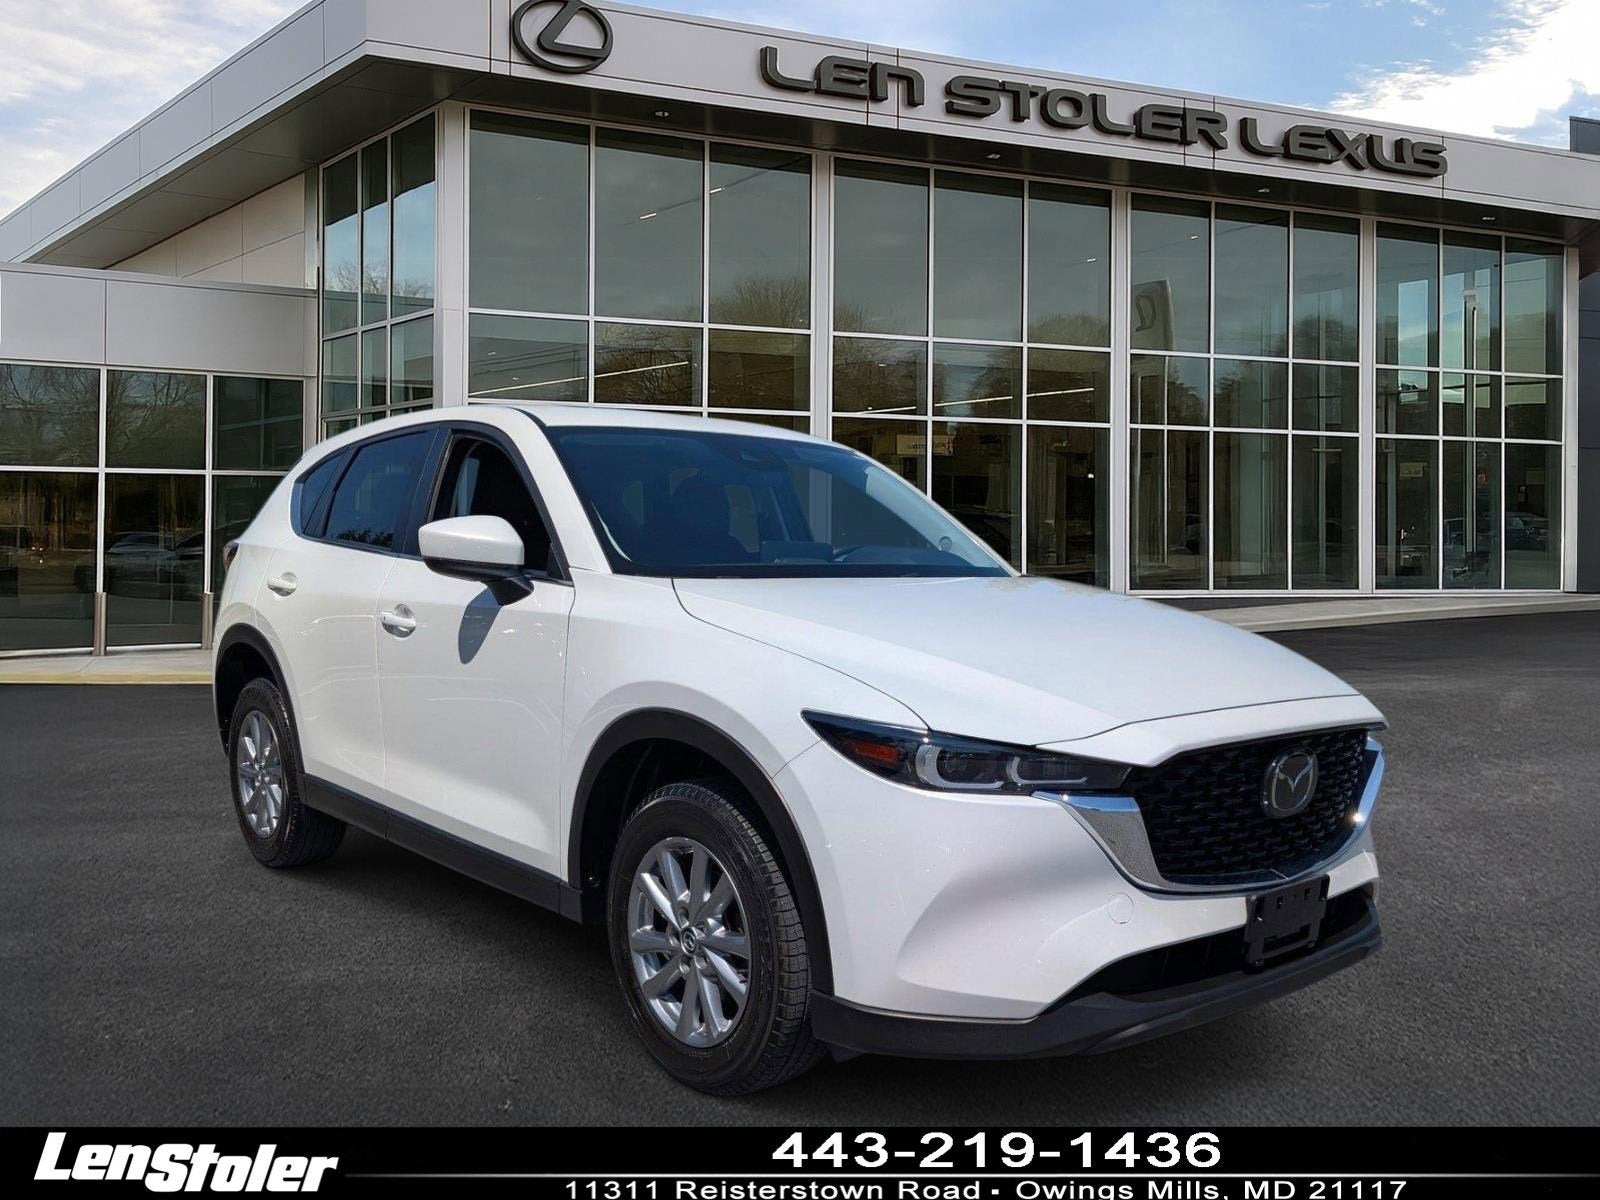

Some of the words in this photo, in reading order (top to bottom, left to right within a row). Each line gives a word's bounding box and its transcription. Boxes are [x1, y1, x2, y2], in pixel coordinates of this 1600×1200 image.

[760, 45, 925, 107] LEN
[945, 75, 1229, 150] STOLER
[1239, 117, 1448, 177] LEXUS
